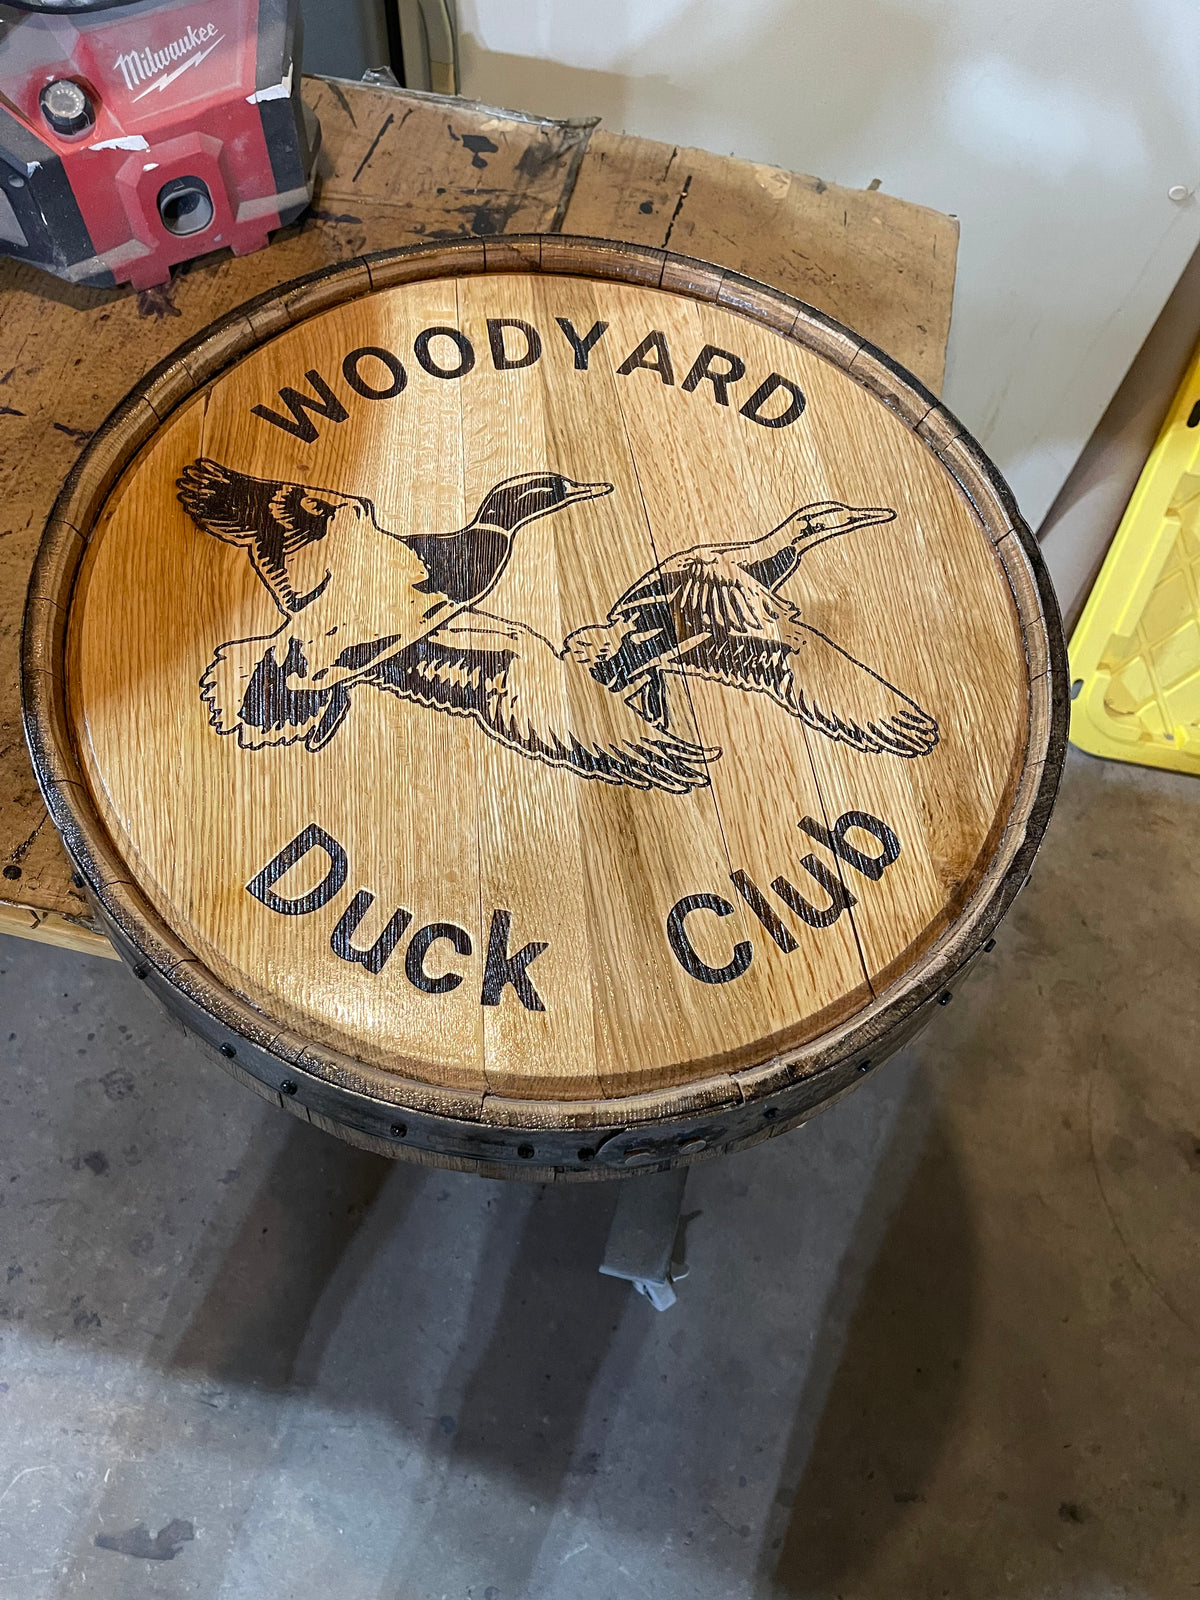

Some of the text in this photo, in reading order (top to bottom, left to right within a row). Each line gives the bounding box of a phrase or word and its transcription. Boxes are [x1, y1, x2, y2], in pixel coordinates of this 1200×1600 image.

[113, 22, 219, 91] Milwaukee
[250, 316, 807, 443] WOODYARD
[245, 810, 901, 1011] Duck Club
